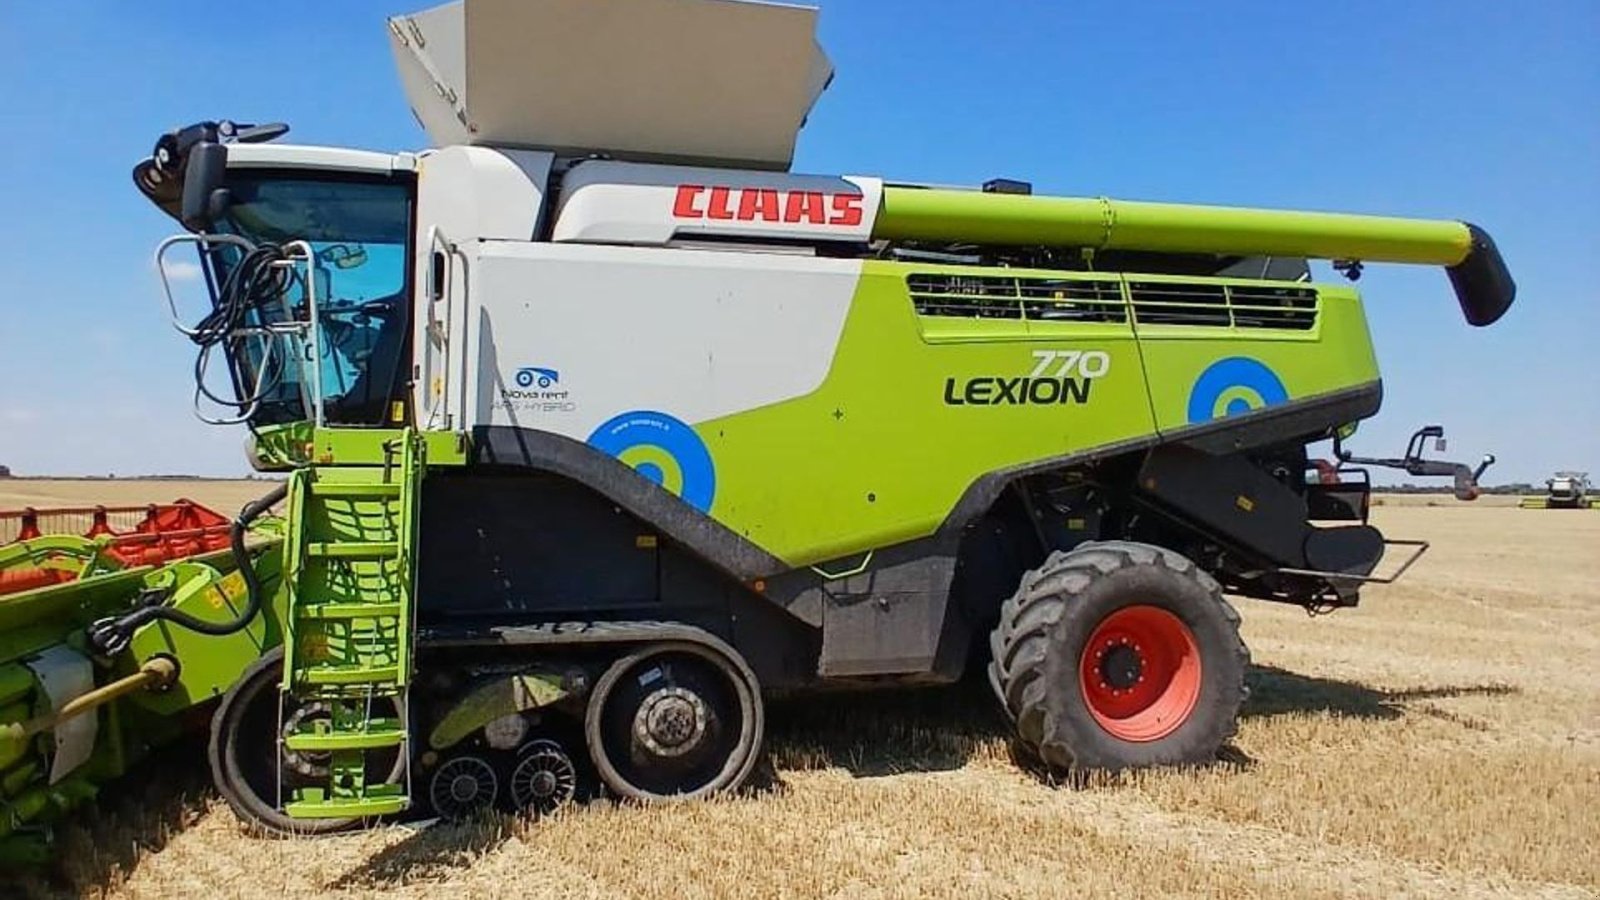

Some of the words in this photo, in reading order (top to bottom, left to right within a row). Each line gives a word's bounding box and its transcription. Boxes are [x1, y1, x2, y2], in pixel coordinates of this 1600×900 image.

[673, 185, 864, 226] CLAAS
[1031, 350, 1110, 379] 770
[944, 377, 1091, 405] LEXION
